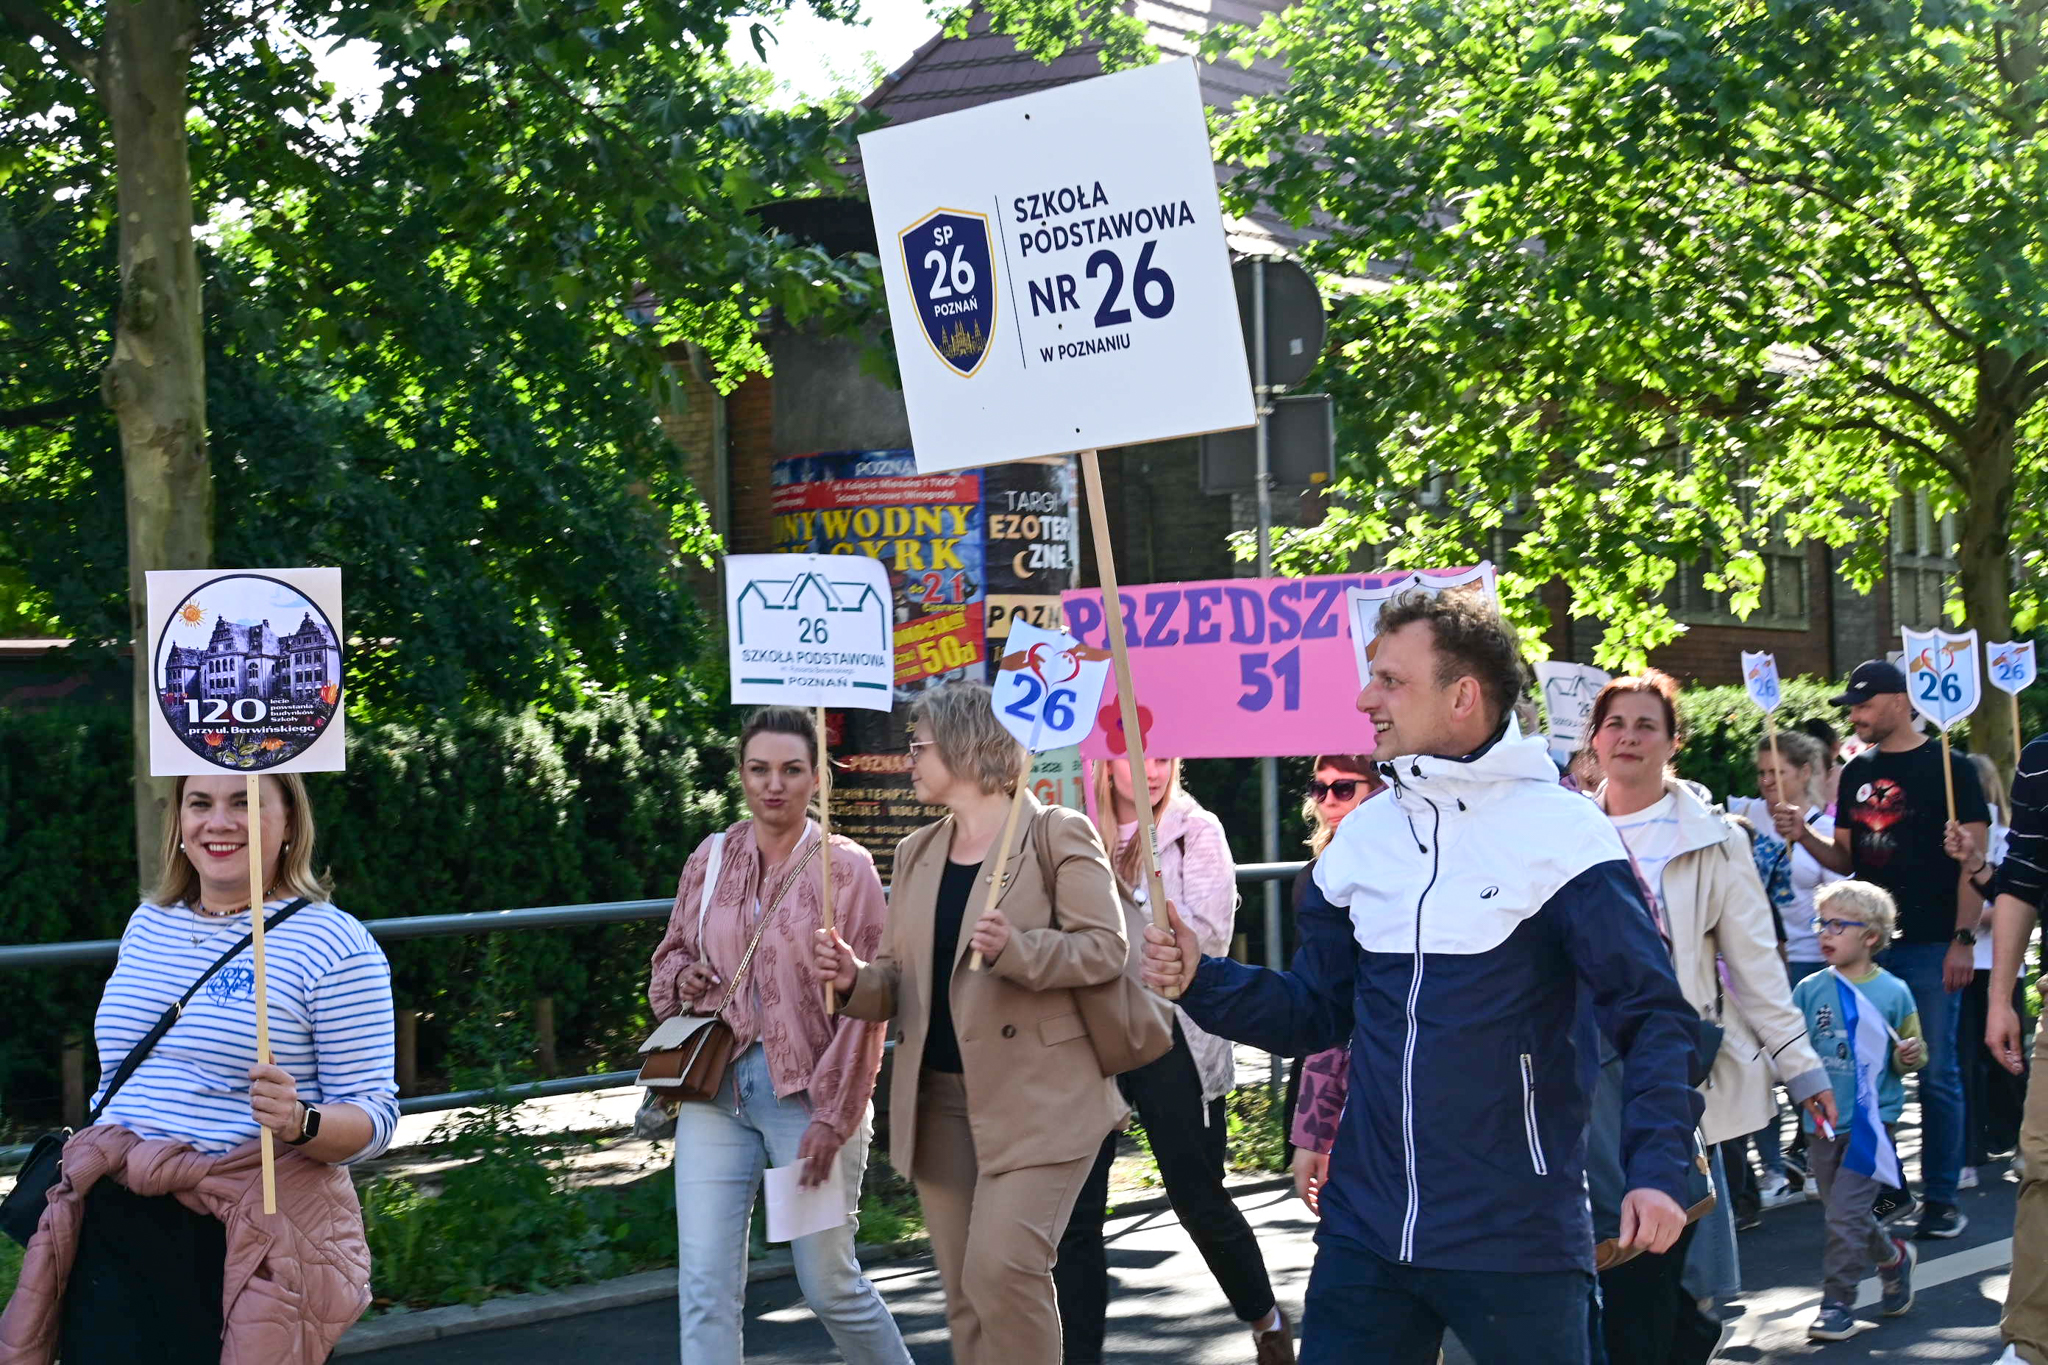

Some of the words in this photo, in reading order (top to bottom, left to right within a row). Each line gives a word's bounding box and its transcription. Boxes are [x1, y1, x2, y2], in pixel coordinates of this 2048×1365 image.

[1014, 181, 1108, 222] SZKOŁA
[934, 226, 953, 246] SP
[1019, 200, 1195, 257] PODSTAWOWA
[924, 245, 975, 299] 26
[1028, 273, 1080, 316] NR
[1086, 240, 1175, 328] 26
[935, 297, 978, 317] POZNAŃ
[1040, 346, 1054, 363] W
[1059, 334, 1130, 360] POZNANIU
[855, 459, 918, 476] POZNA
[821, 505, 975, 540] WODNY
[921, 572, 966, 603] 21
[1064, 577, 1405, 649] PRZEDSZ
[799, 617, 828, 644] 26
[742, 649, 794, 663] SZKOŁA
[797, 651, 886, 668] PODSTAWOWA
[1998, 664, 2024, 681] 26
[788, 676, 848, 687] POZNAŃ
[1238, 646, 1300, 712] 51
[1753, 678, 1775, 697] 26
[1919, 672, 1962, 703] 26
[184, 699, 266, 722] 120
[1005, 674, 1077, 731] 26
[216, 726, 229, 734] ul.
[231, 725, 315, 735] Berwińskiego
